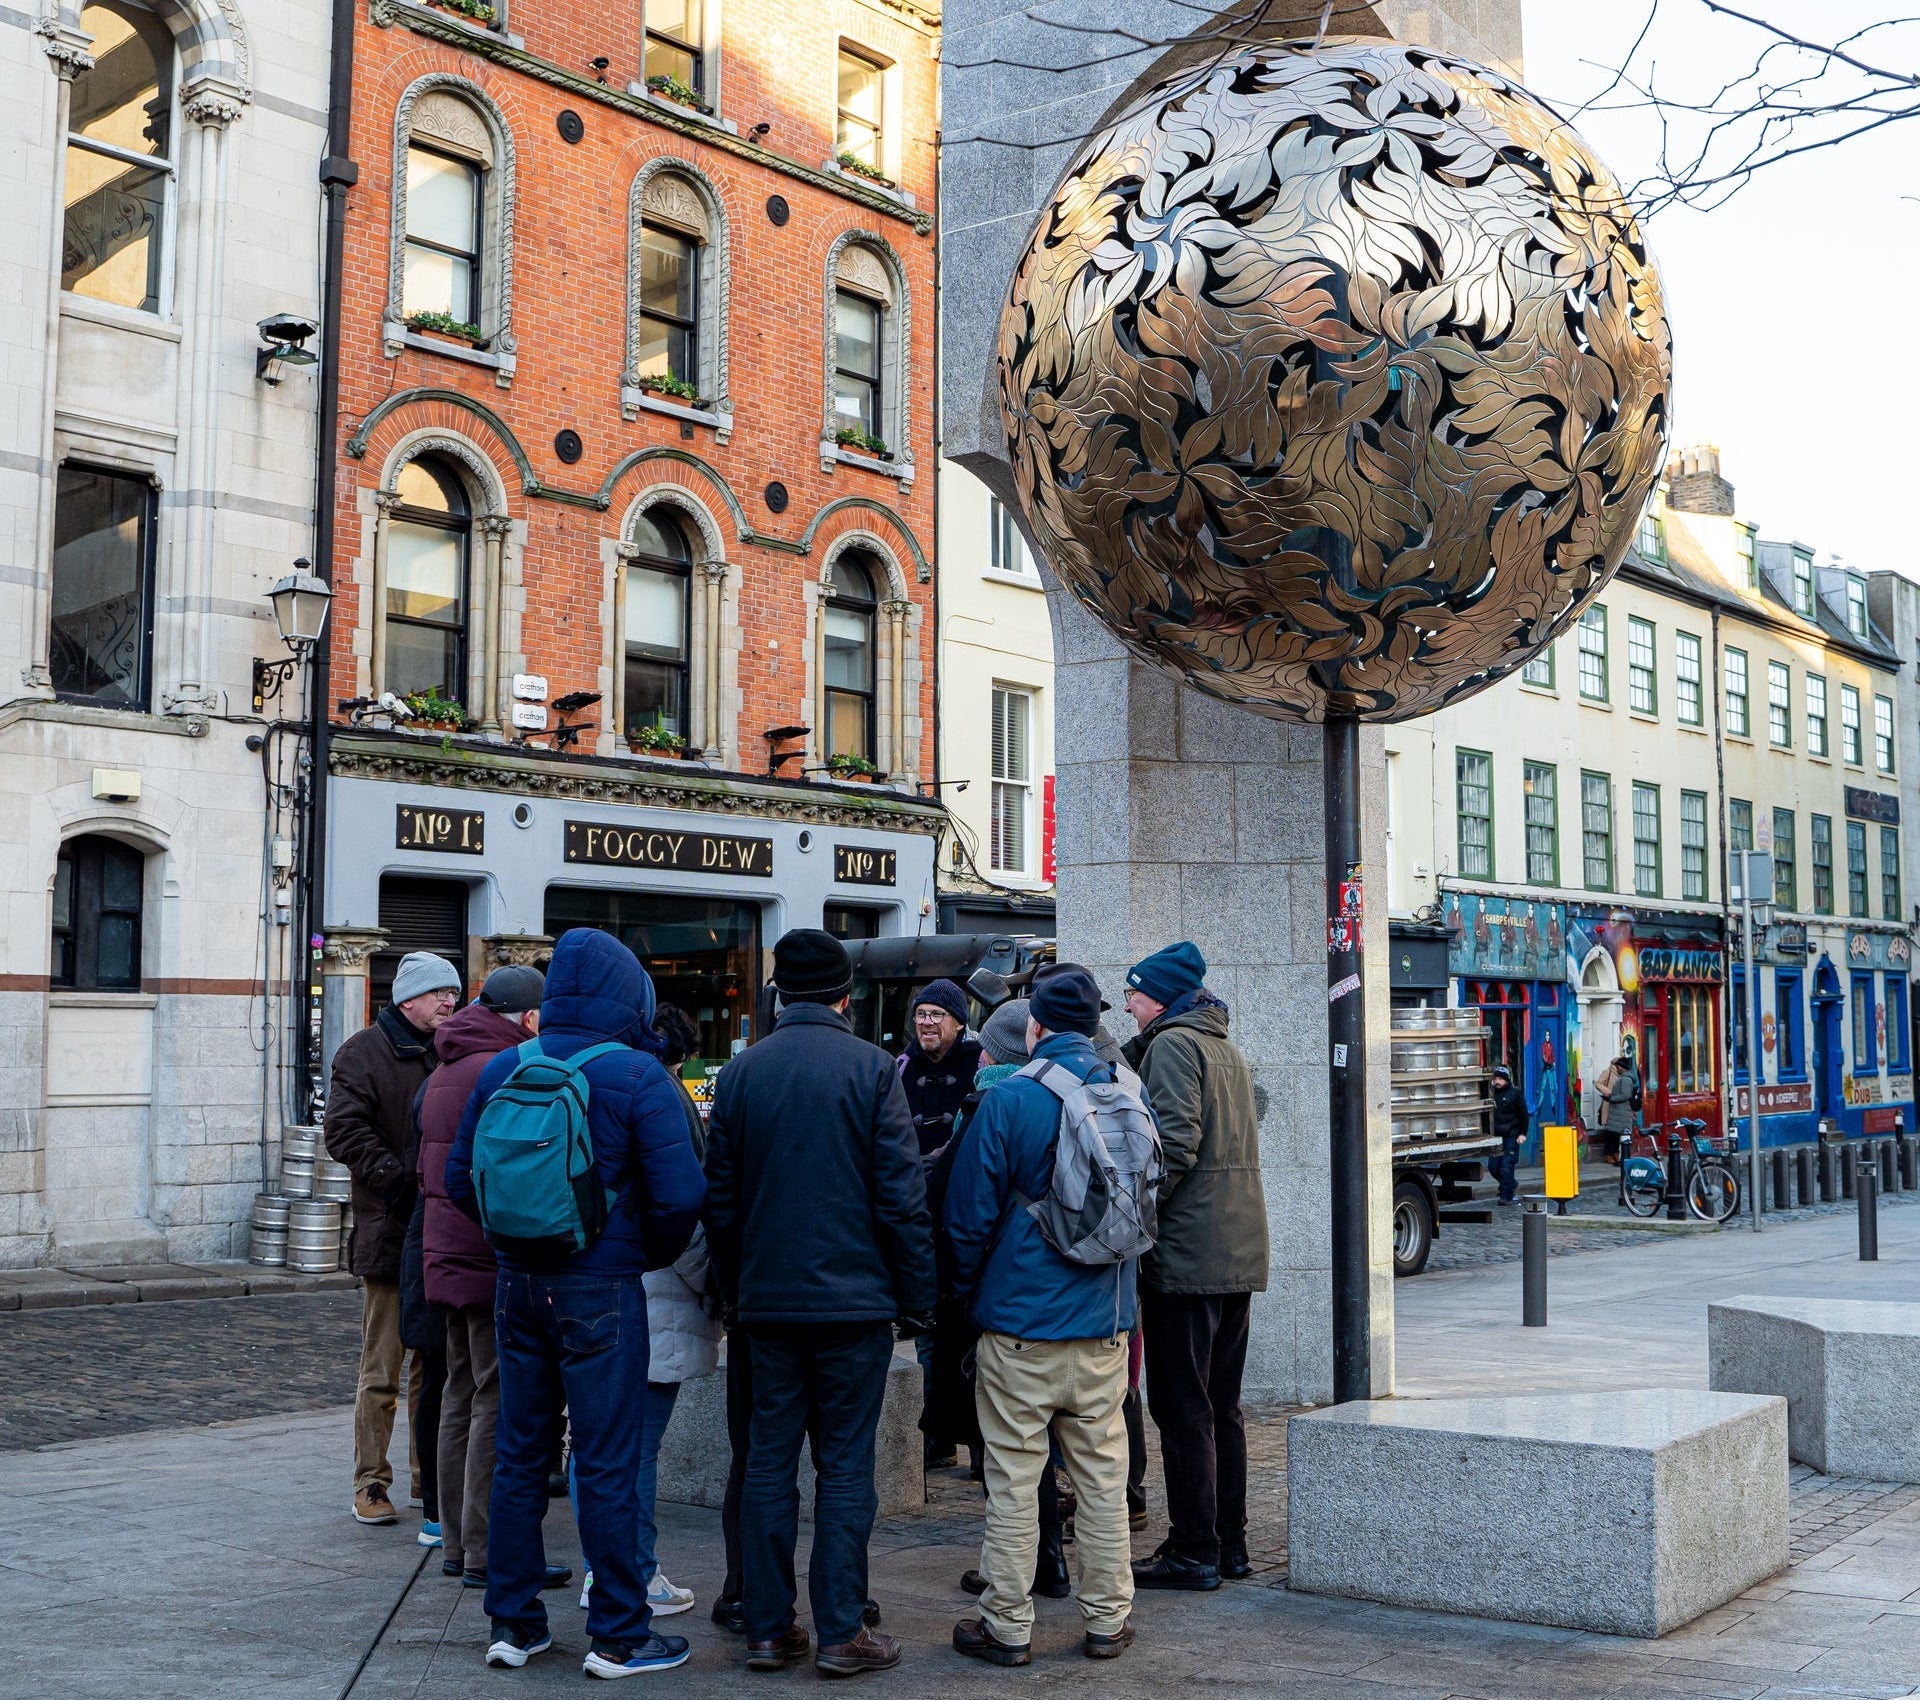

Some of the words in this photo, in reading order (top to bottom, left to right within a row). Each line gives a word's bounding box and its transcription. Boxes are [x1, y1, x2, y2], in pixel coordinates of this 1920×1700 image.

[461, 816, 470, 847] 1
[586, 827, 684, 864] FOGGY
[702, 838, 757, 869] DEW
[880, 854, 887, 880] 1
[1854, 1088, 1871, 1104] DUB
